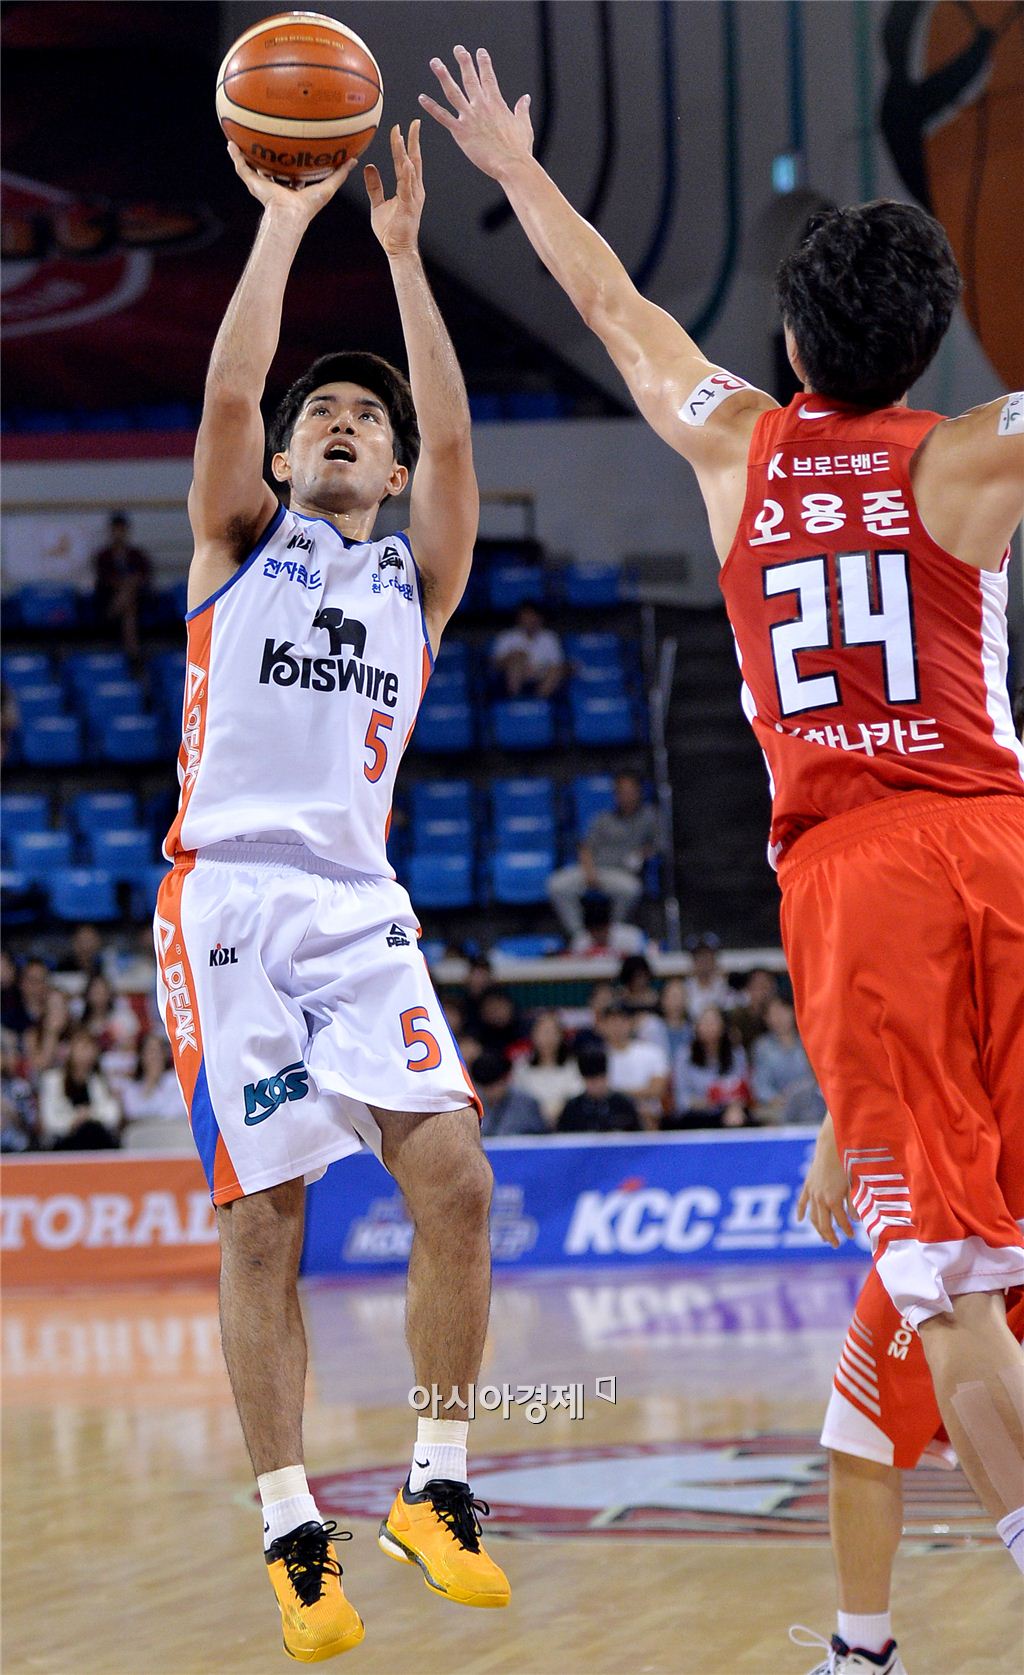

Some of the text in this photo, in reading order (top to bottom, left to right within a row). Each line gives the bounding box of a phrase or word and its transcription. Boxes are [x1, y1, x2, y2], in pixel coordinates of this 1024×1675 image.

[251, 143, 347, 168] molten
[792, 452, 890, 476] 브로드밴드
[761, 549, 922, 720] 24
[363, 708, 395, 784] 5
[163, 962, 199, 1056] PEAK
[399, 1006, 442, 1072] 5
[243, 1060, 310, 1126] KOS
[564, 1176, 721, 1256] KCC
